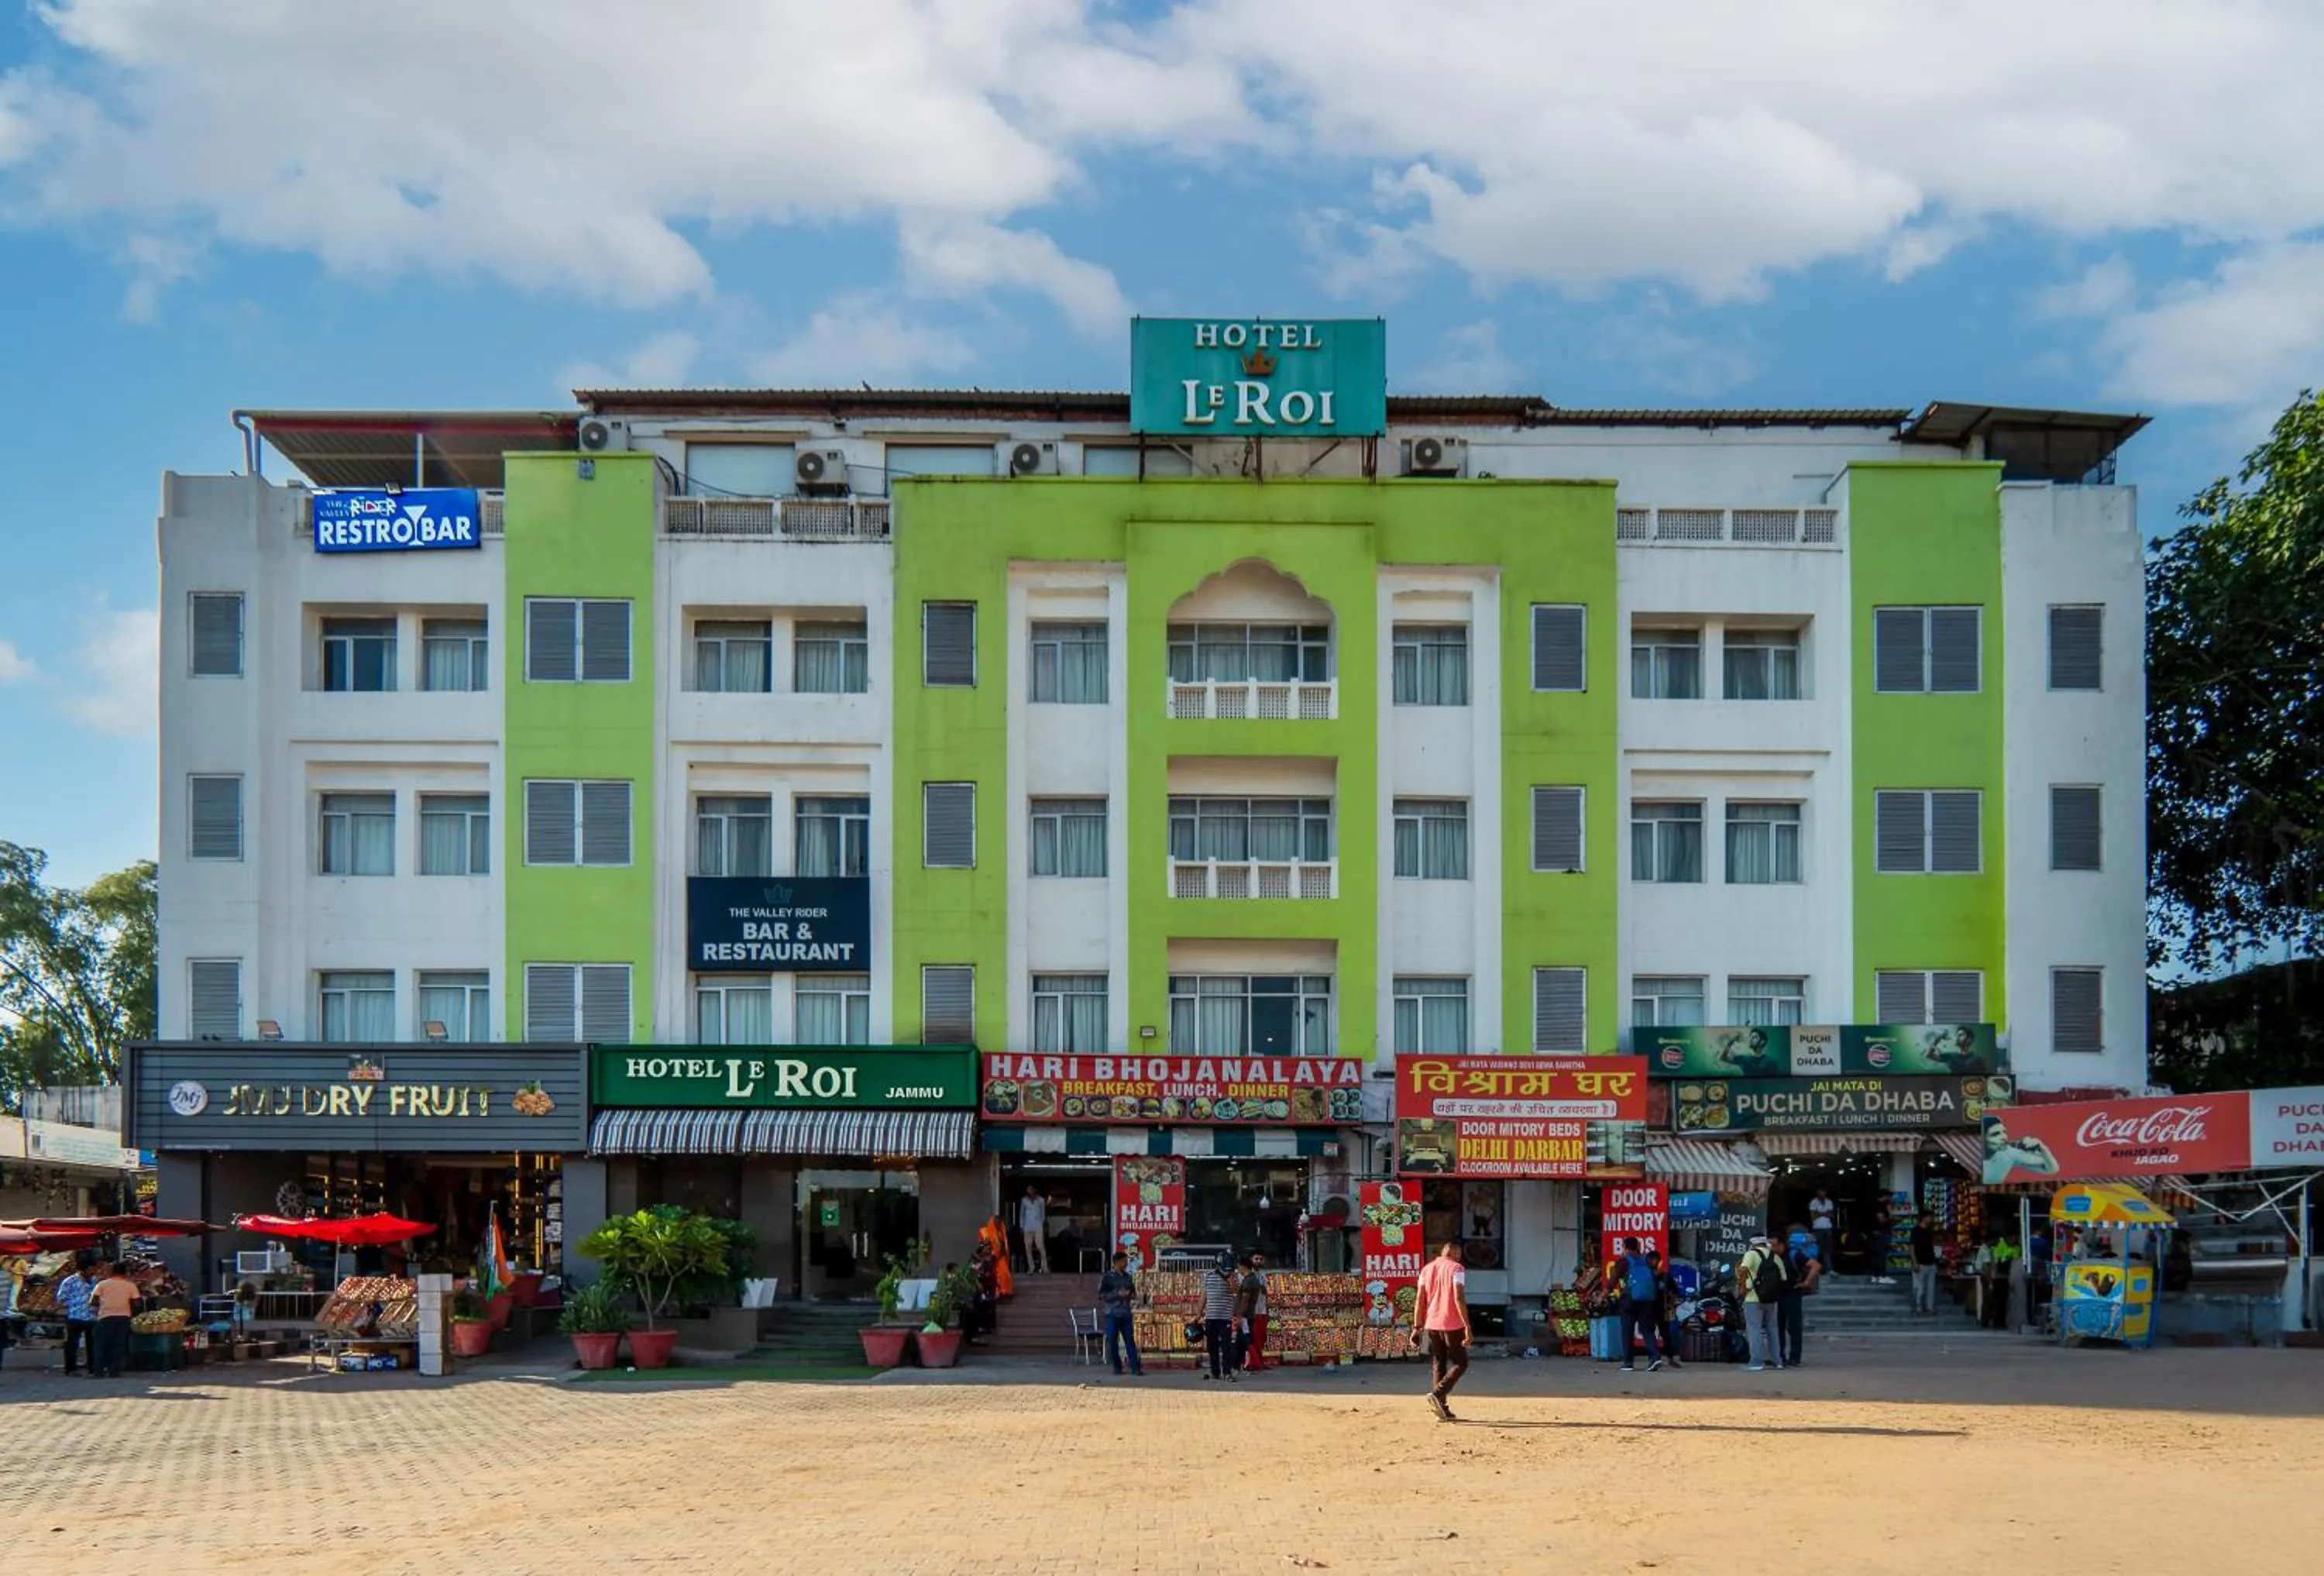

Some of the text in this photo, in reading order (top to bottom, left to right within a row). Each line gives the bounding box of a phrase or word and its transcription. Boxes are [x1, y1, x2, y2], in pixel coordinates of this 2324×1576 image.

[1195, 323, 1322, 348] HOTEL
[1233, 380, 1335, 425] ROI
[319, 515, 472, 545] RESTRO BAR
[729, 907, 827, 917] THE VALLEY RIDER
[743, 922, 813, 940] BAR &
[703, 943, 854, 961] RESTAURANT
[1800, 1034, 1831, 1043] PUCHI
[1808, 1046, 1823, 1055] DA
[992, 1056, 1360, 1084] HARI BHOJANALAYA
[1797, 1058, 1834, 1066] DHABA
[626, 1058, 722, 1078] HOTEL
[775, 1059, 857, 1098] ROI
[885, 1087, 944, 1099] JAMMU
[1410, 1061, 1636, 1096] विश्राम घर
[1810, 1081, 1882, 1091] JAI MATA DI
[1229, 1084, 1288, 1097] DINNER
[303, 1084, 376, 1116] DRY
[390, 1085, 490, 1116] FRUIT
[1736, 1091, 1954, 1113] PUCHI DA DHABA
[1764, 1113, 1930, 1126] BREAKFAST LUNCH DINNER
[2077, 1106, 2212, 1147] Coca-Cola
[1462, 1122, 1581, 1137] DOOR MITORY BEDS
[1459, 1138, 1584, 1161] DELHI DARBAR
[1559, 1163, 1583, 1174] HERE
[1611, 1188, 1657, 1208] DOOR
[1121, 1204, 1177, 1221] HARI
[1603, 1212, 1665, 1231] MITORY
[1721, 1213, 1756, 1227] UCHI
[1722, 1228, 1742, 1240] DA
[1366, 1253, 1420, 1270] HARI
